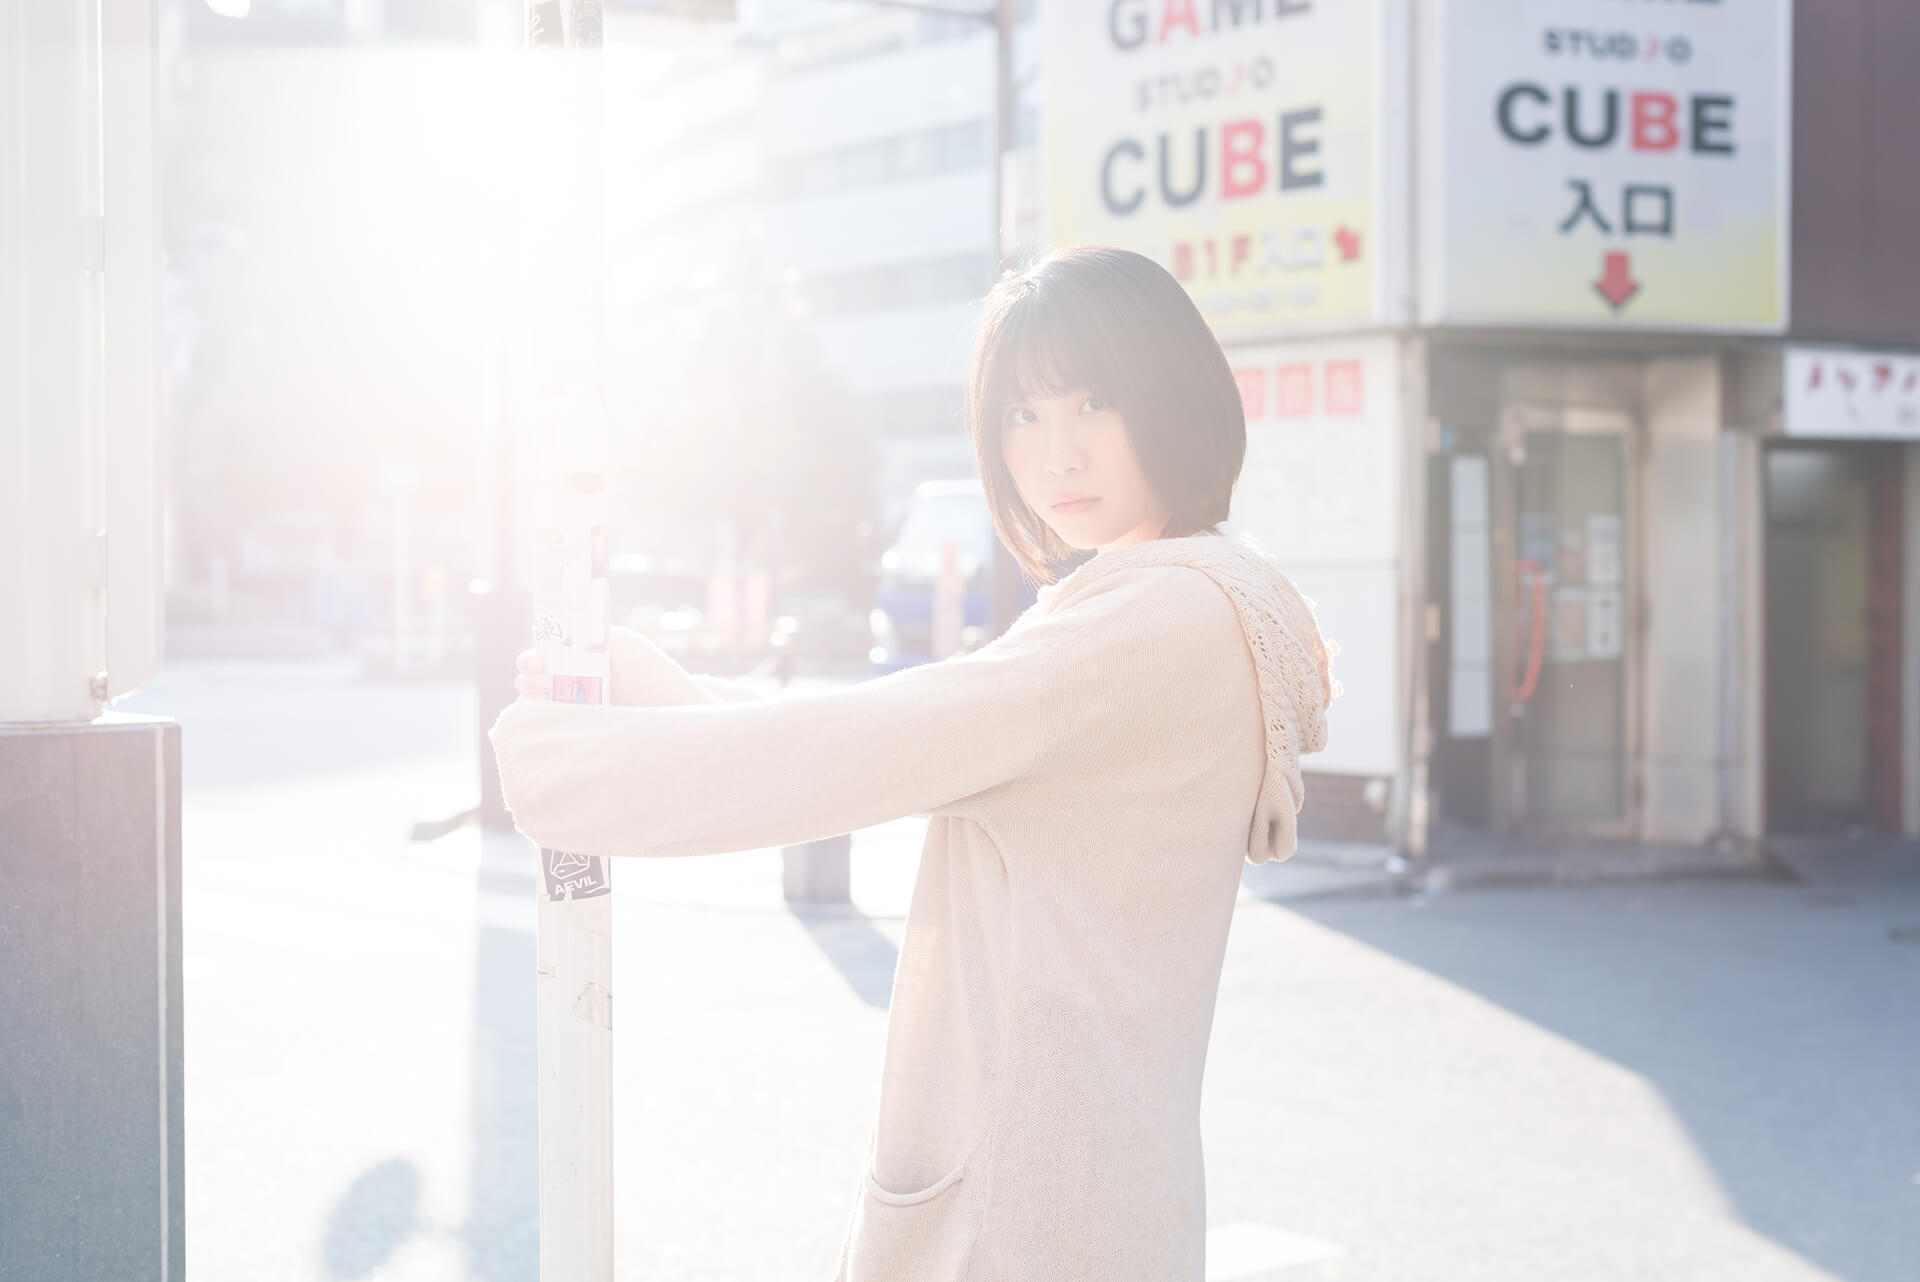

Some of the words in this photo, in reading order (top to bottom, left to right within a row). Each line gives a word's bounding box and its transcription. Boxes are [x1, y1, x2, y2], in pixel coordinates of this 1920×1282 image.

[1497, 82, 1737, 156] CUBE
[1100, 106, 1325, 216] CUBE
[1558, 178, 1675, 238] 入口
